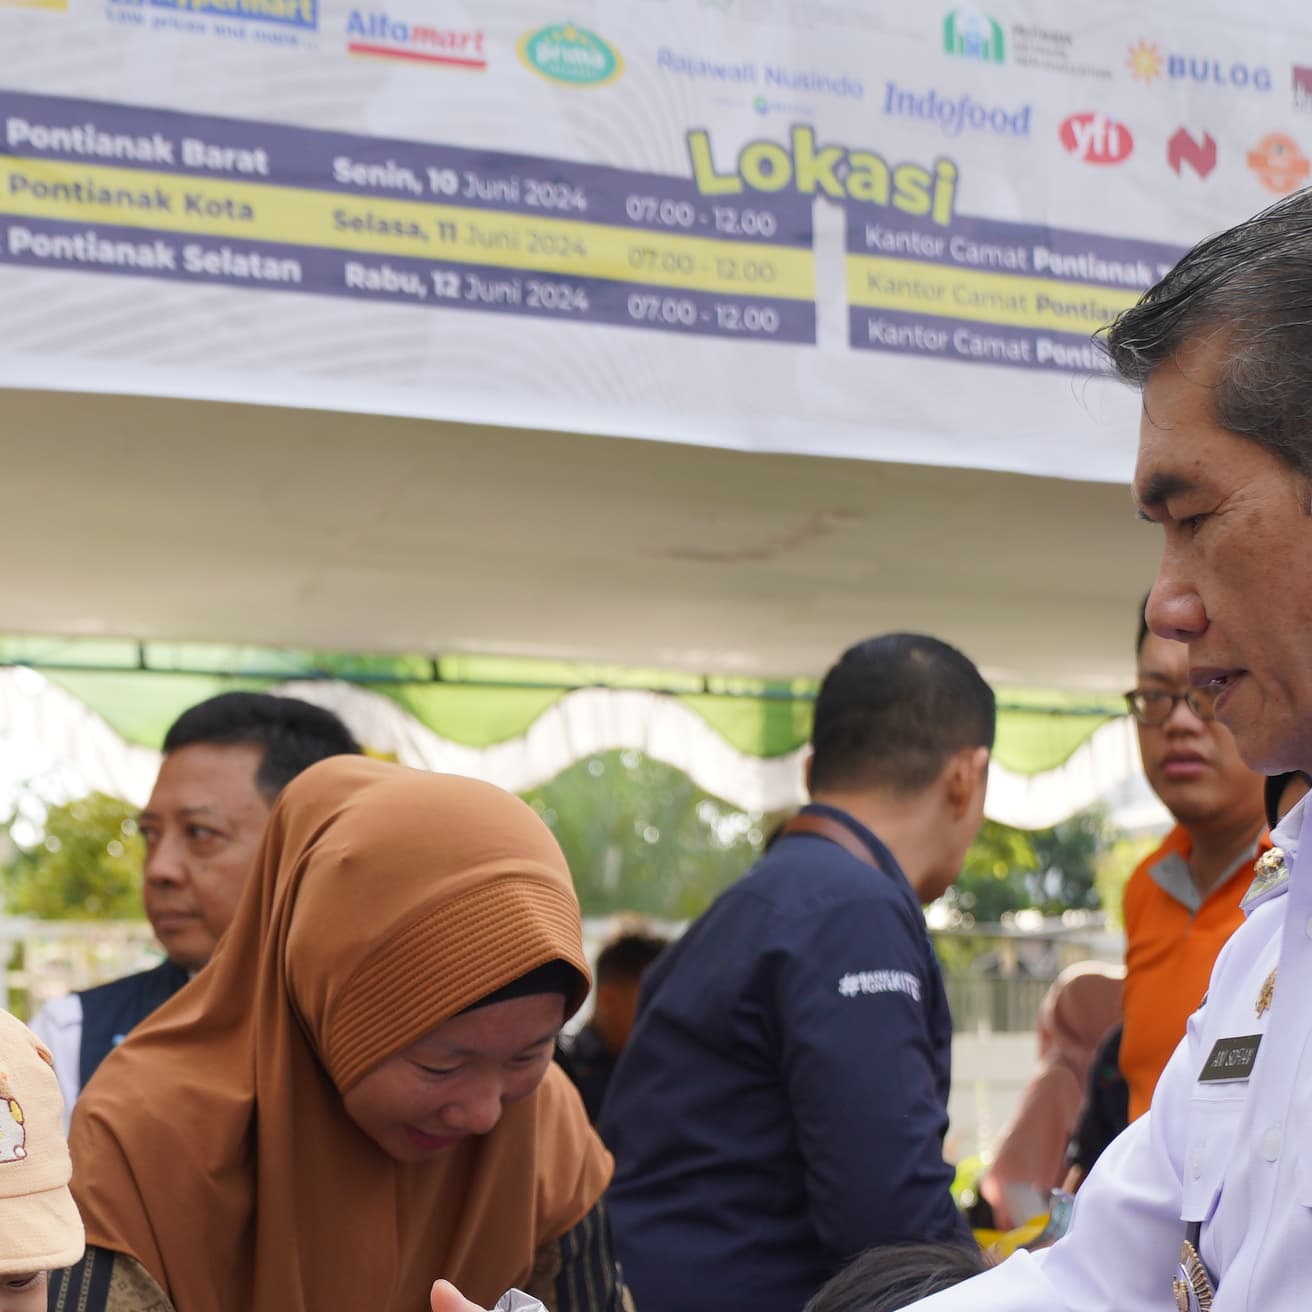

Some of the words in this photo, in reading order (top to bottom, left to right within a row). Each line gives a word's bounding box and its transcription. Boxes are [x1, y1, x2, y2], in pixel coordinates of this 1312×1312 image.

[346, 10, 485, 54] Alfamart
[656, 46, 757, 84] Rajawali
[763, 64, 865, 99] Nusindo
[1168, 54, 1272, 92] BULOG
[884, 80, 1032, 138] Indofood
[6, 117, 175, 165] Pontianak
[181, 137, 270, 175] Barat
[8, 173, 174, 213] Pontianak
[183, 192, 256, 222] Kota
[333, 156, 423, 196] Senin,
[426, 166, 459, 196] 10
[463, 171, 520, 204] Juni
[524, 178, 587, 211] 2024
[625, 195, 695, 228] 07.00
[712, 205, 777, 237] 12.00
[688, 124, 958, 228] Lokasi
[7, 226, 176, 270] Pontianak
[182, 244, 303, 283] Selatan
[332, 208, 429, 242] Selasa,
[436, 219, 458, 242] 11
[465, 224, 520, 251] Juni
[527, 230, 588, 257] 2024
[628, 245, 695, 275] 07.00
[715, 256, 777, 284] 12.00
[865, 223, 944, 258] Kantor
[950, 236, 1029, 272] Camat
[1033, 246, 1151, 287] Pontianak
[344, 261, 427, 298] Rabu,
[431, 269, 461, 299] 12
[464, 273, 523, 306] Juni
[526, 279, 589, 312] 2024
[627, 293, 697, 326] 07.00
[715, 303, 780, 333] 12.00
[867, 271, 945, 298] Kantor
[952, 282, 1029, 314] Camat
[868, 319, 947, 351] Kantor
[953, 328, 1031, 363] Camat
